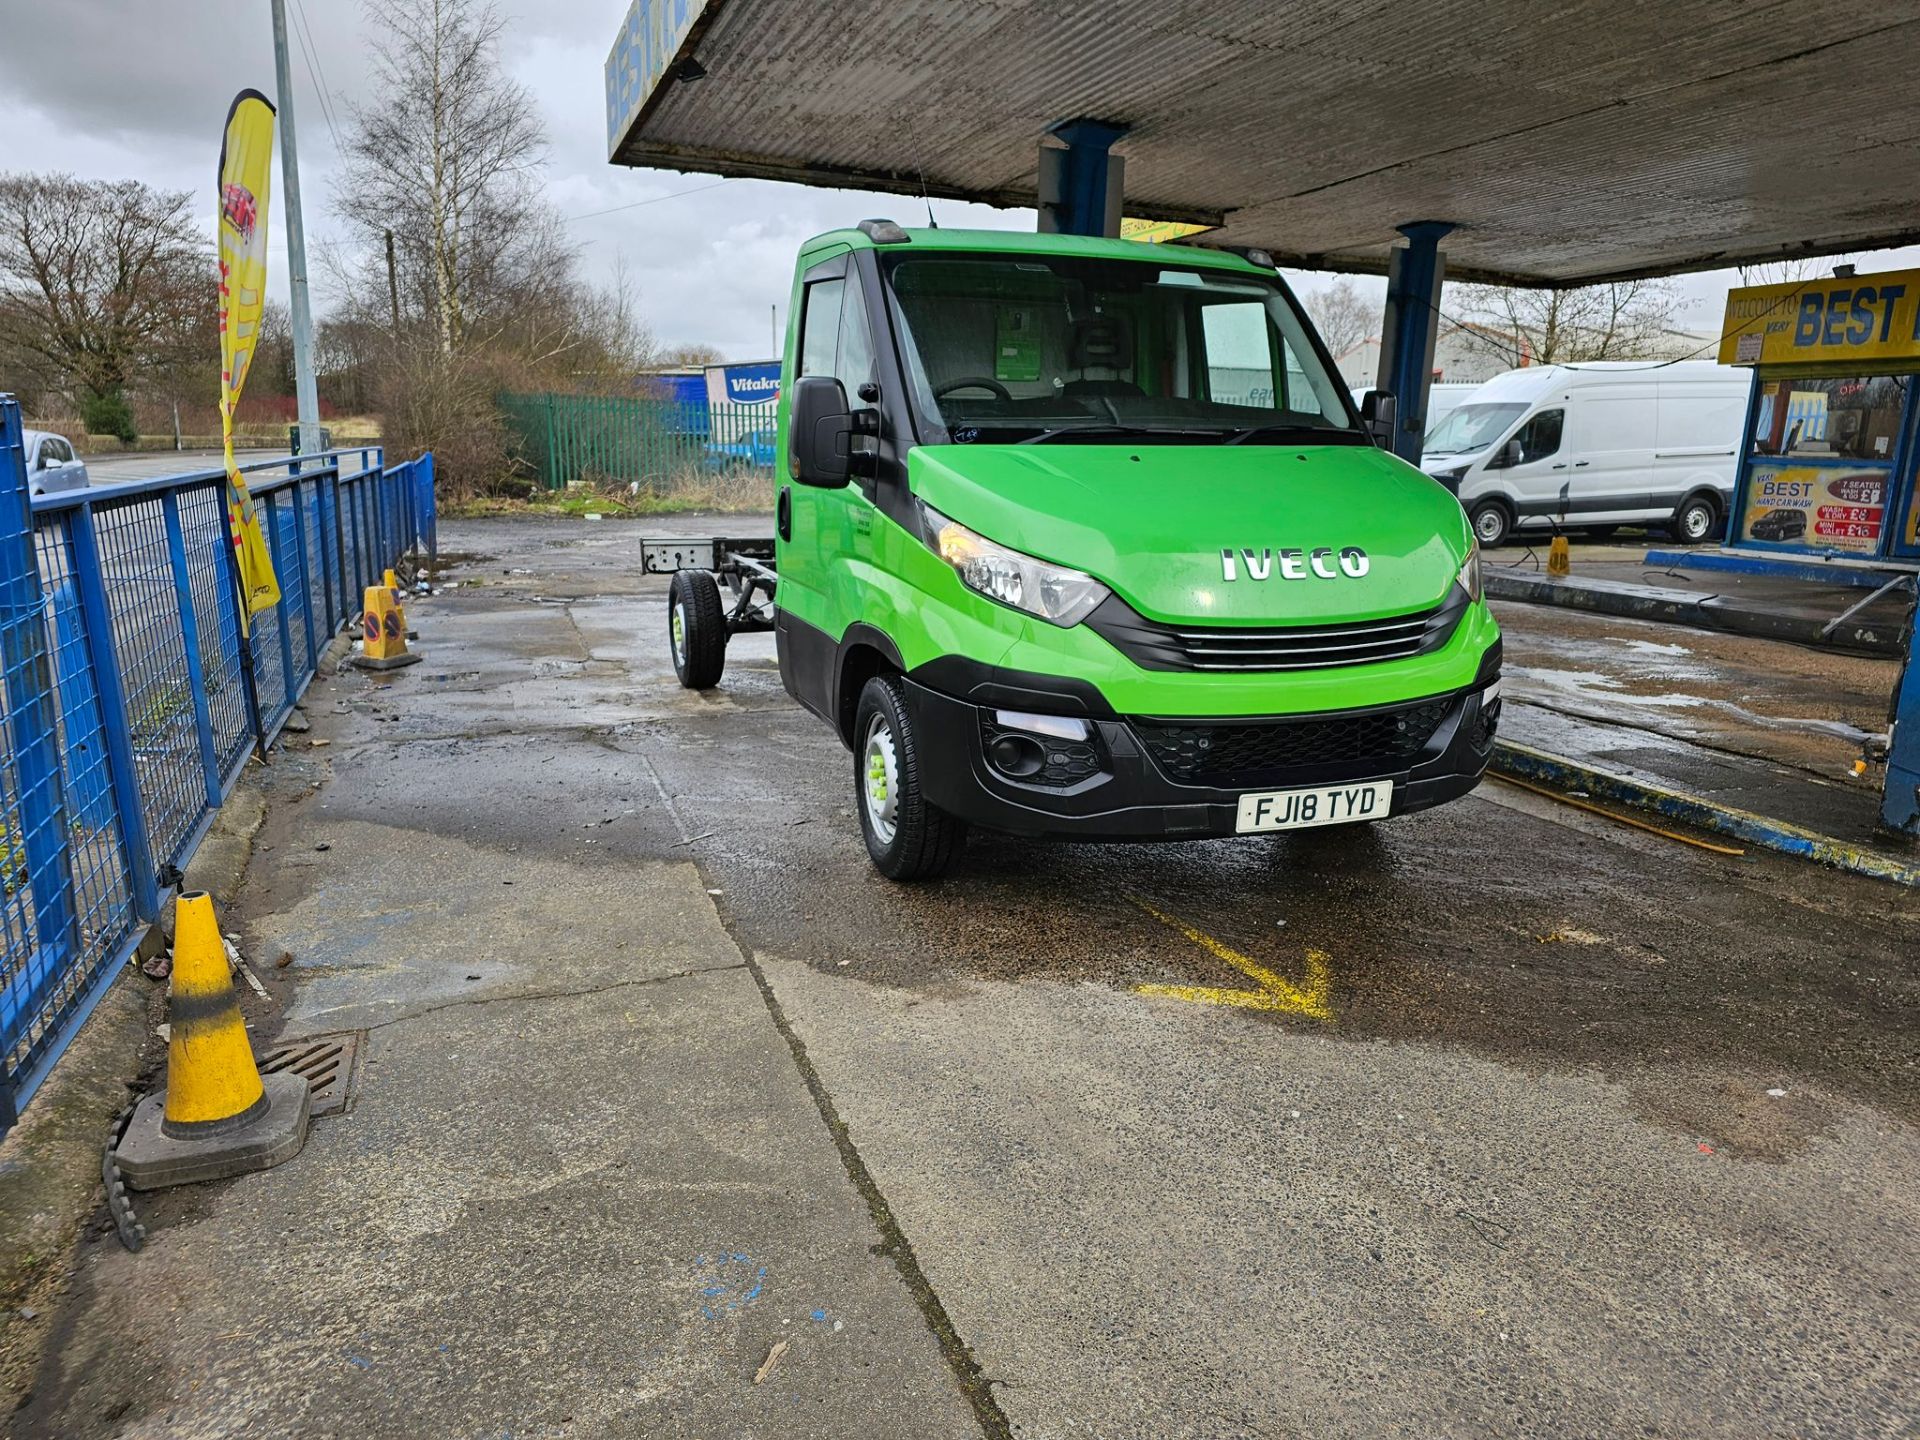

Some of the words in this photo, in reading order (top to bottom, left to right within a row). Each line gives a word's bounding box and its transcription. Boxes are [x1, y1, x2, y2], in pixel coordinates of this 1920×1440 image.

[1793, 285, 1906, 347] BEST
[1763, 481, 1813, 497] BEST
[1849, 481, 1881, 489] SEATER
[1831, 512, 1847, 520] DRY
[1822, 528, 1845, 536] VALET
[1220, 546, 1371, 582] IVECO
[1254, 795, 1318, 827] FJ18
[1327, 787, 1376, 819] TYD
